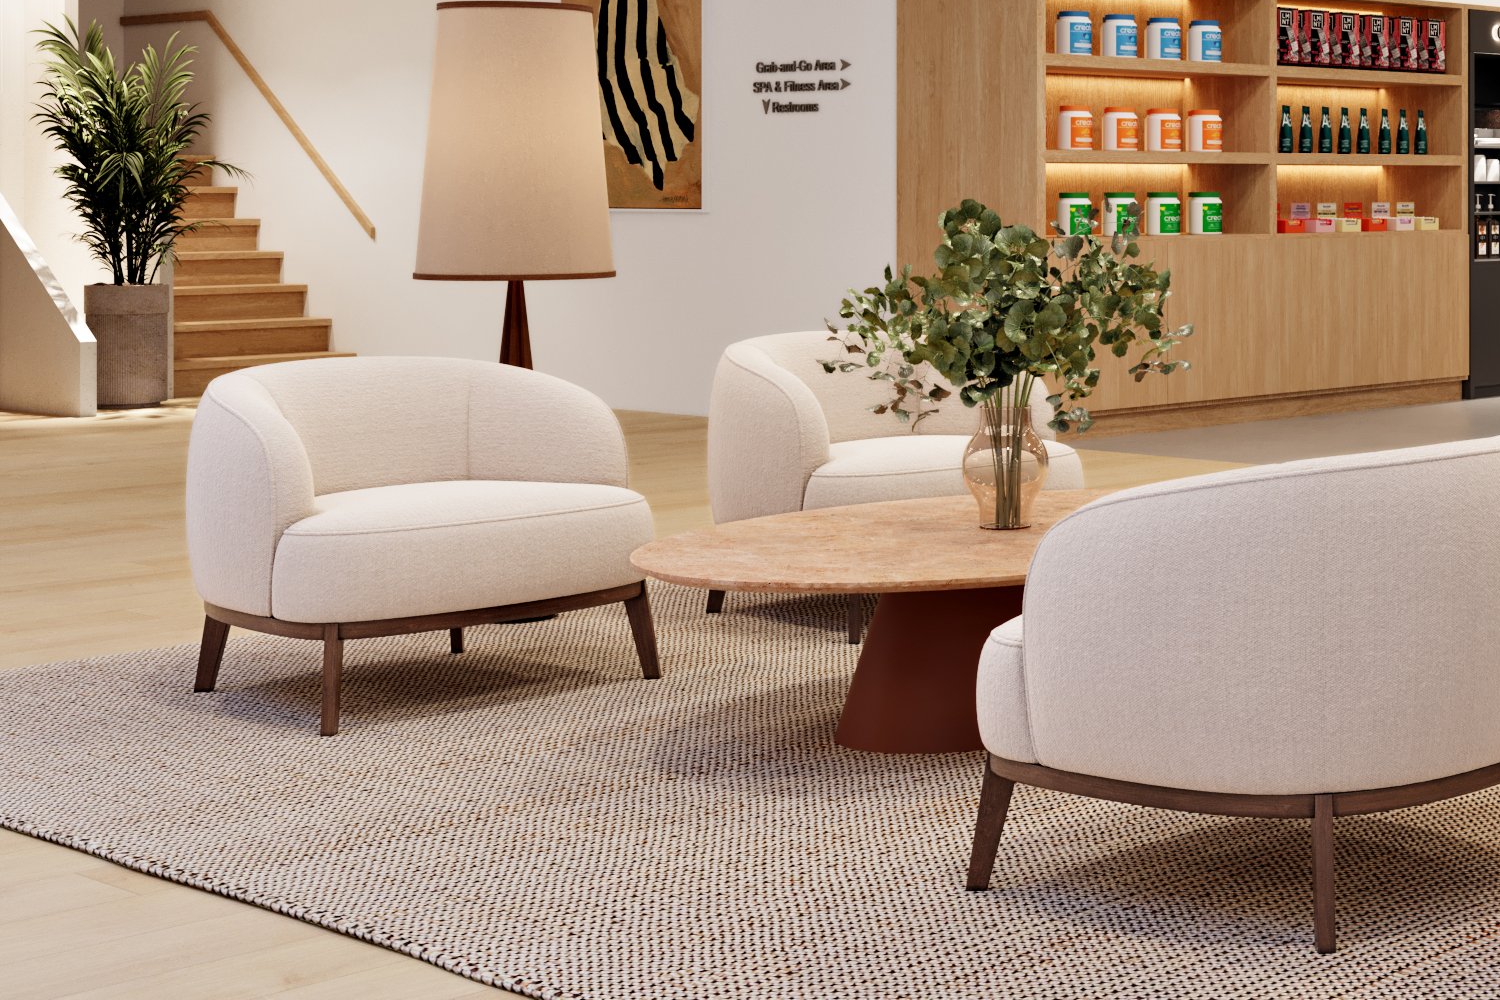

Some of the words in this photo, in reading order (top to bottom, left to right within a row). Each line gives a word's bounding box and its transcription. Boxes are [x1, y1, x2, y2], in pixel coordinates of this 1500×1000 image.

[755, 60, 813, 73] Grab-and-Go
[814, 59, 836, 71] Area
[752, 81, 773, 93] SPA
[774, 81, 782, 93] &
[784, 80, 816, 92] Fitness
[817, 80, 839, 91] Area
[772, 101, 819, 113] Restrooms
